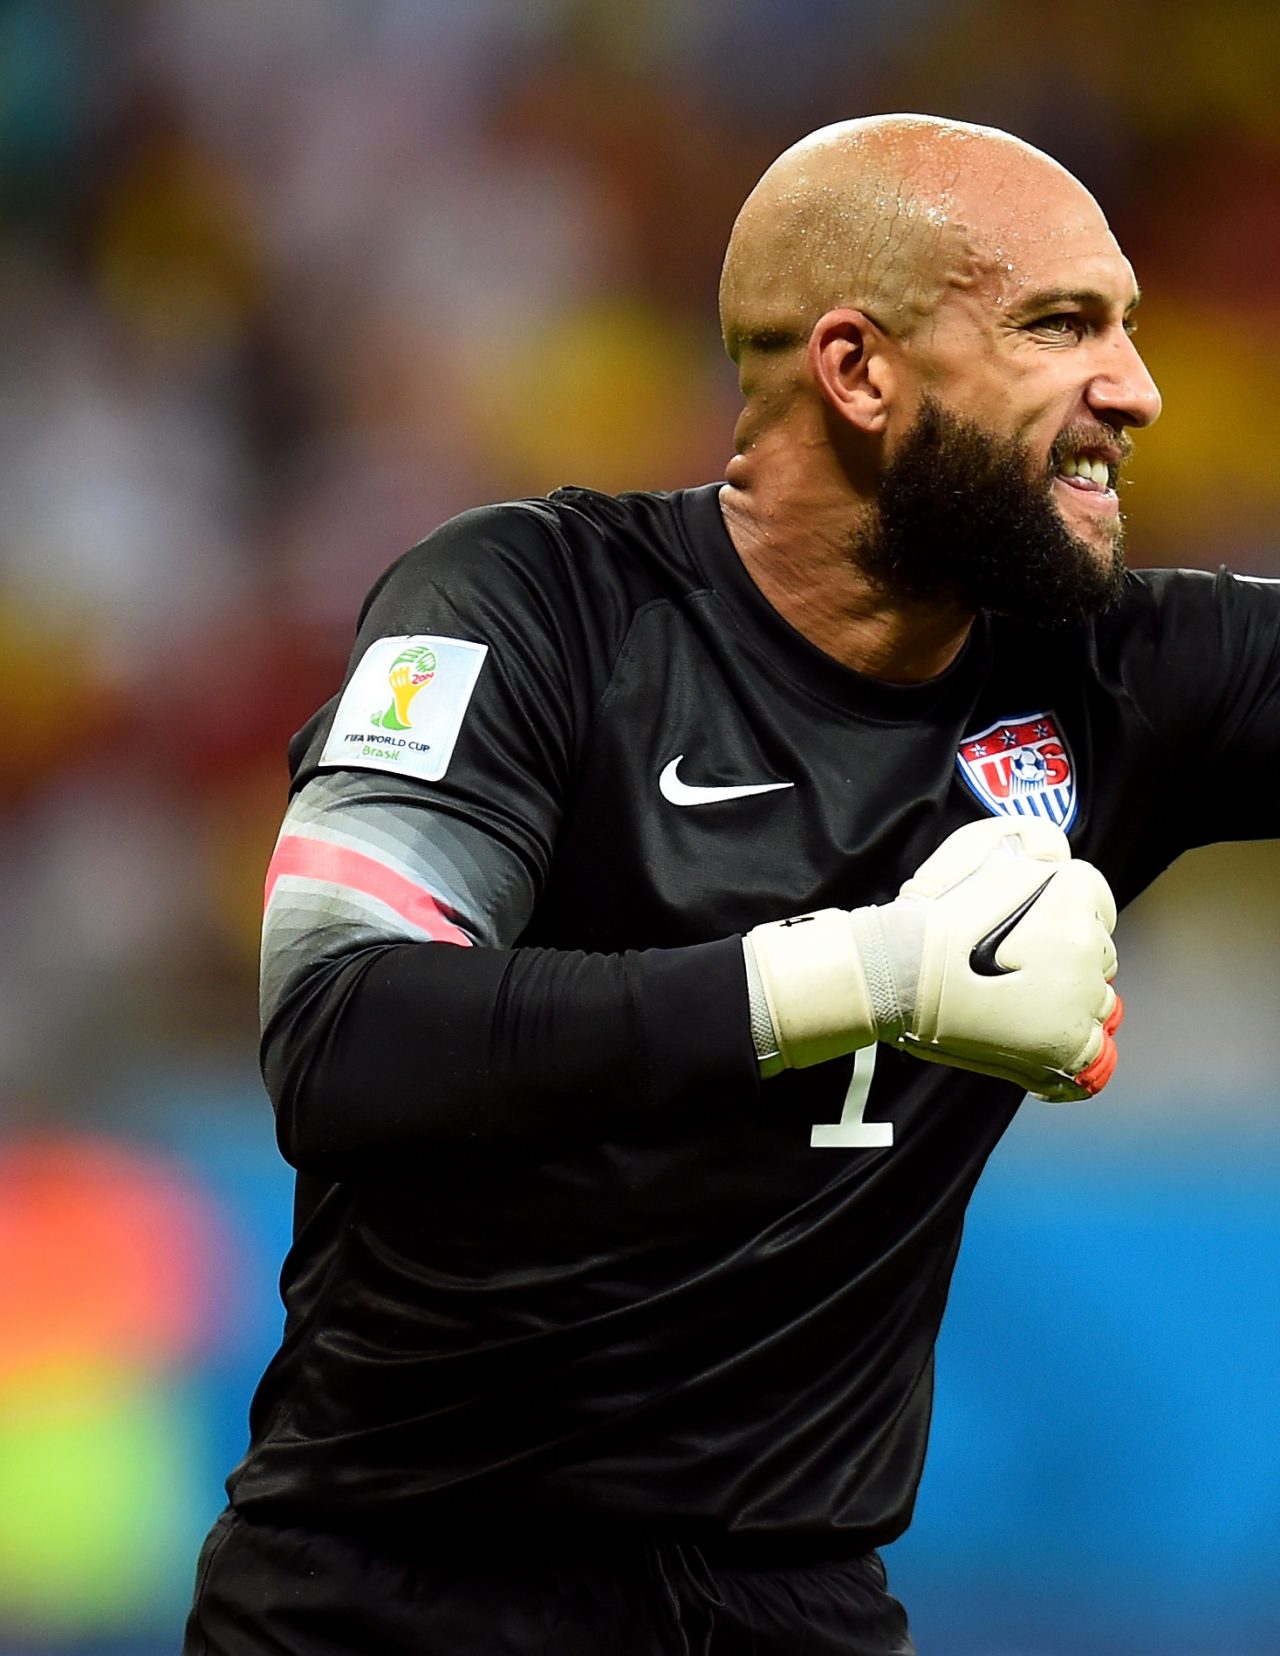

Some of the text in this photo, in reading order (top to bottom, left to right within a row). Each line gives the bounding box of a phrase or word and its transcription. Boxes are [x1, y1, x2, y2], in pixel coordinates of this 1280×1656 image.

[344, 733, 431, 753] FIFA WORLD CUP
[362, 744, 401, 761] Brasil
